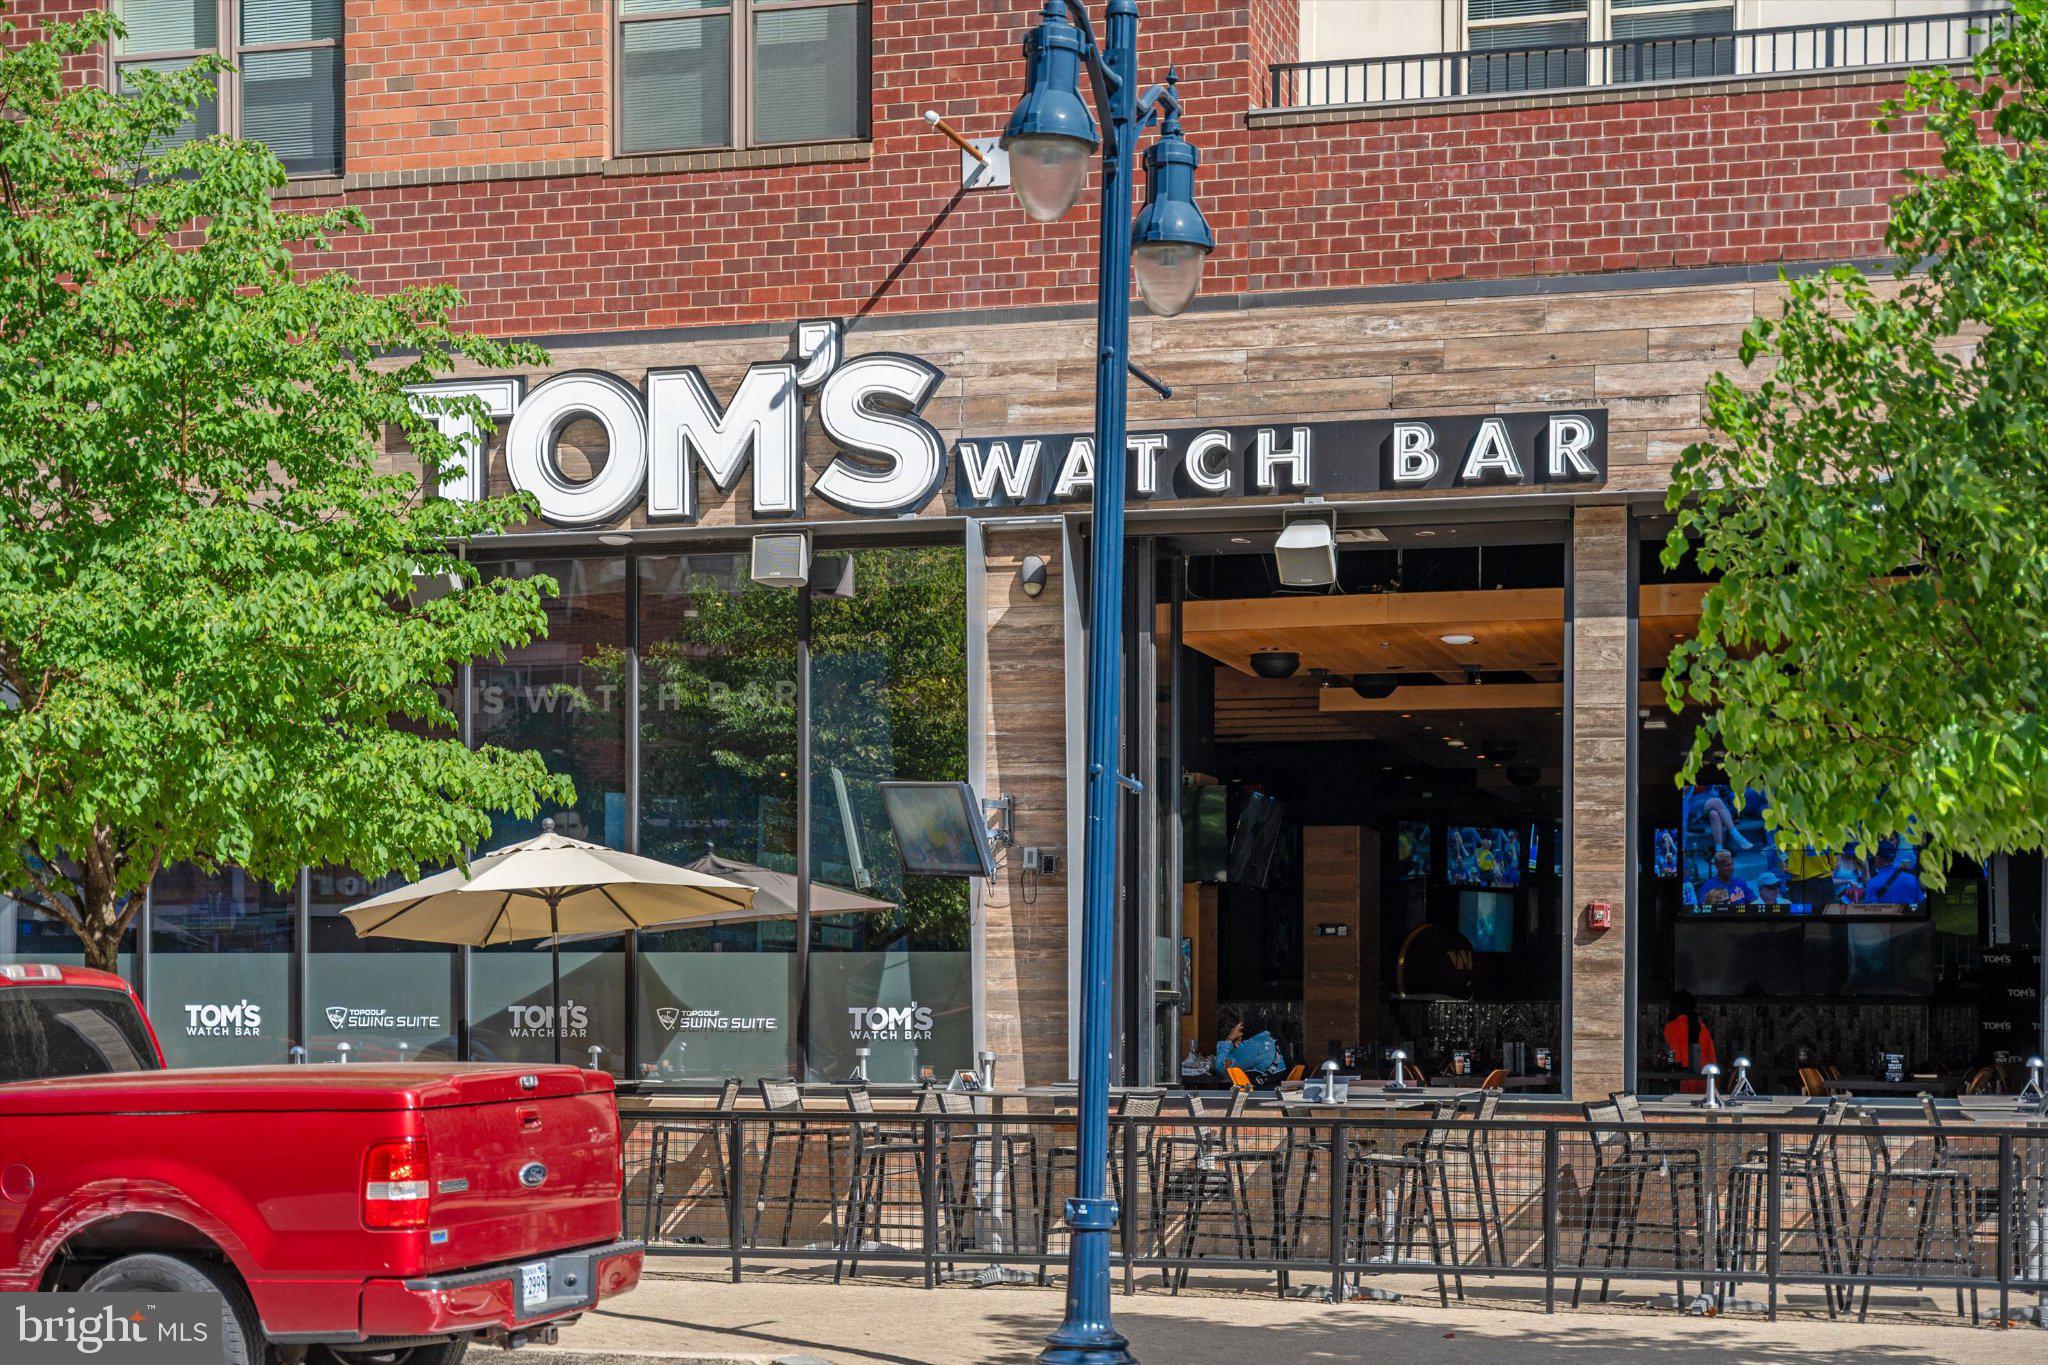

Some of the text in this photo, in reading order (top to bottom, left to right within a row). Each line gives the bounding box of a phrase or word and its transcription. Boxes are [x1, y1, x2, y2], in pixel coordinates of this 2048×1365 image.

[404, 318, 1600, 528] TOM'S WATCH BAR
[1983, 955, 2012, 963] TOM'S
[2008, 988, 2036, 997] TOM'S
[184, 999, 261, 1027] TOM'S
[507, 1000, 588, 1029] TOM'S
[848, 1001, 934, 1031] TOM'S
[348, 1016, 393, 1027] SWING
[680, 1017, 727, 1029] SWING
[1983, 1021, 2012, 1030] TOM'S
[186, 1026, 260, 1036] WATCH BAR
[509, 1028, 587, 1038] WATCH BAR
[850, 1031, 932, 1040] WATCH BAR
